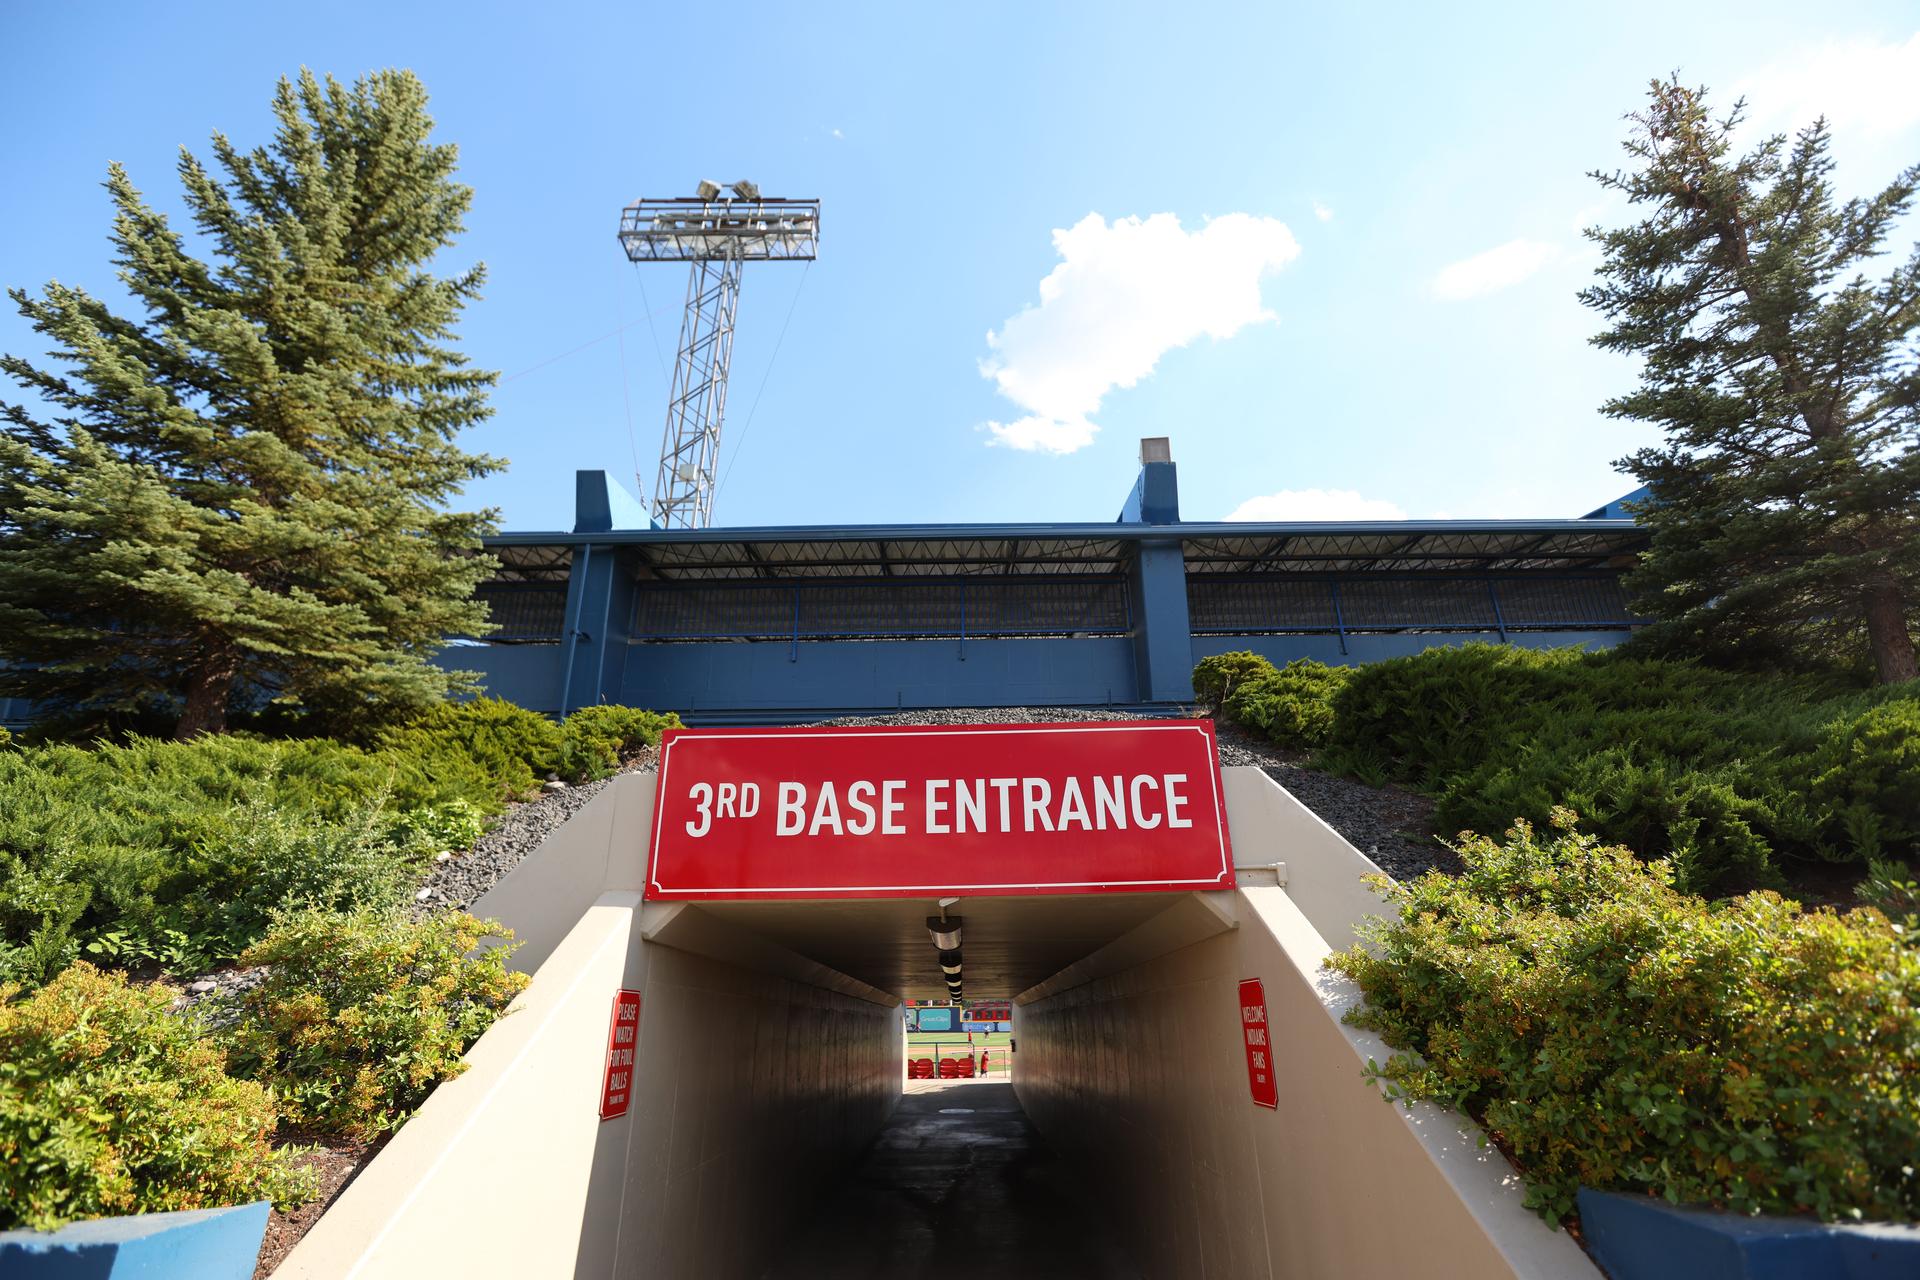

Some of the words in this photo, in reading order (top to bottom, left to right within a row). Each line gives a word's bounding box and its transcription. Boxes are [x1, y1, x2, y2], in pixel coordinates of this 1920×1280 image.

[685, 781, 760, 838] 3RD
[776, 779, 907, 837] BASE
[926, 773, 1193, 835] ENTRANCE
[617, 1003, 637, 1021] PLEASE
[1242, 1006, 1265, 1023] WELCOME
[615, 1026, 634, 1043] WATCH
[1247, 1028, 1266, 1046] INDIANS
[609, 1049, 620, 1068] FOR
[620, 1048, 632, 1067] FOUL
[1252, 1051, 1266, 1069] FANS
[610, 1071, 627, 1091] BALLS
